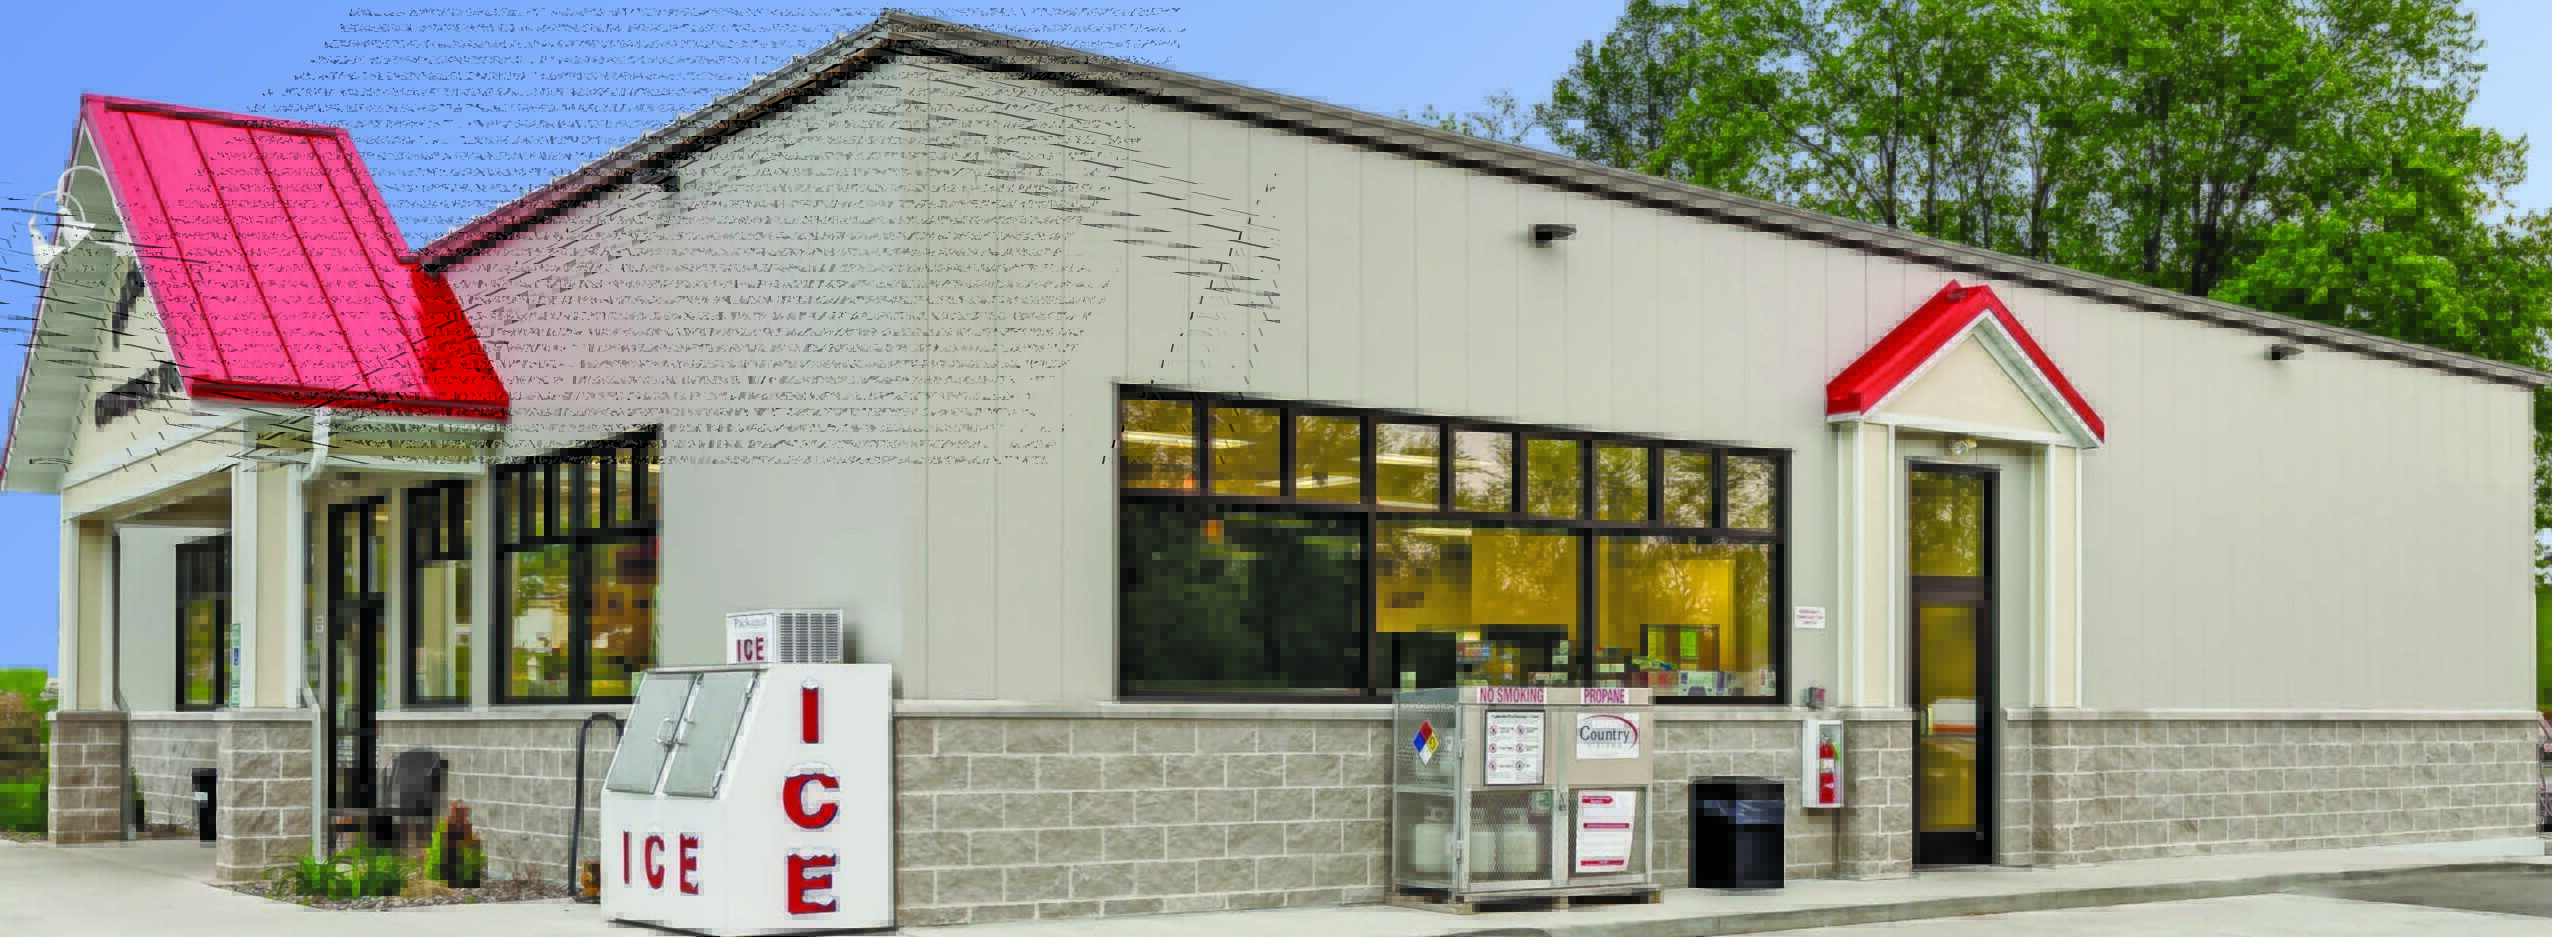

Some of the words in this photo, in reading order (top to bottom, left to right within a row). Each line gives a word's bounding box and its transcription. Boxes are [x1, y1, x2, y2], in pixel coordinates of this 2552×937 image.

[737, 636, 764, 662] ICE
[1480, 687, 1494, 703] NO
[1497, 687, 1544, 703] SMOKING
[1583, 688, 1625, 704] PROPANE
[1580, 725, 1630, 744] Country
[783, 684, 840, 915] ICE
[622, 829, 699, 896] ICE
